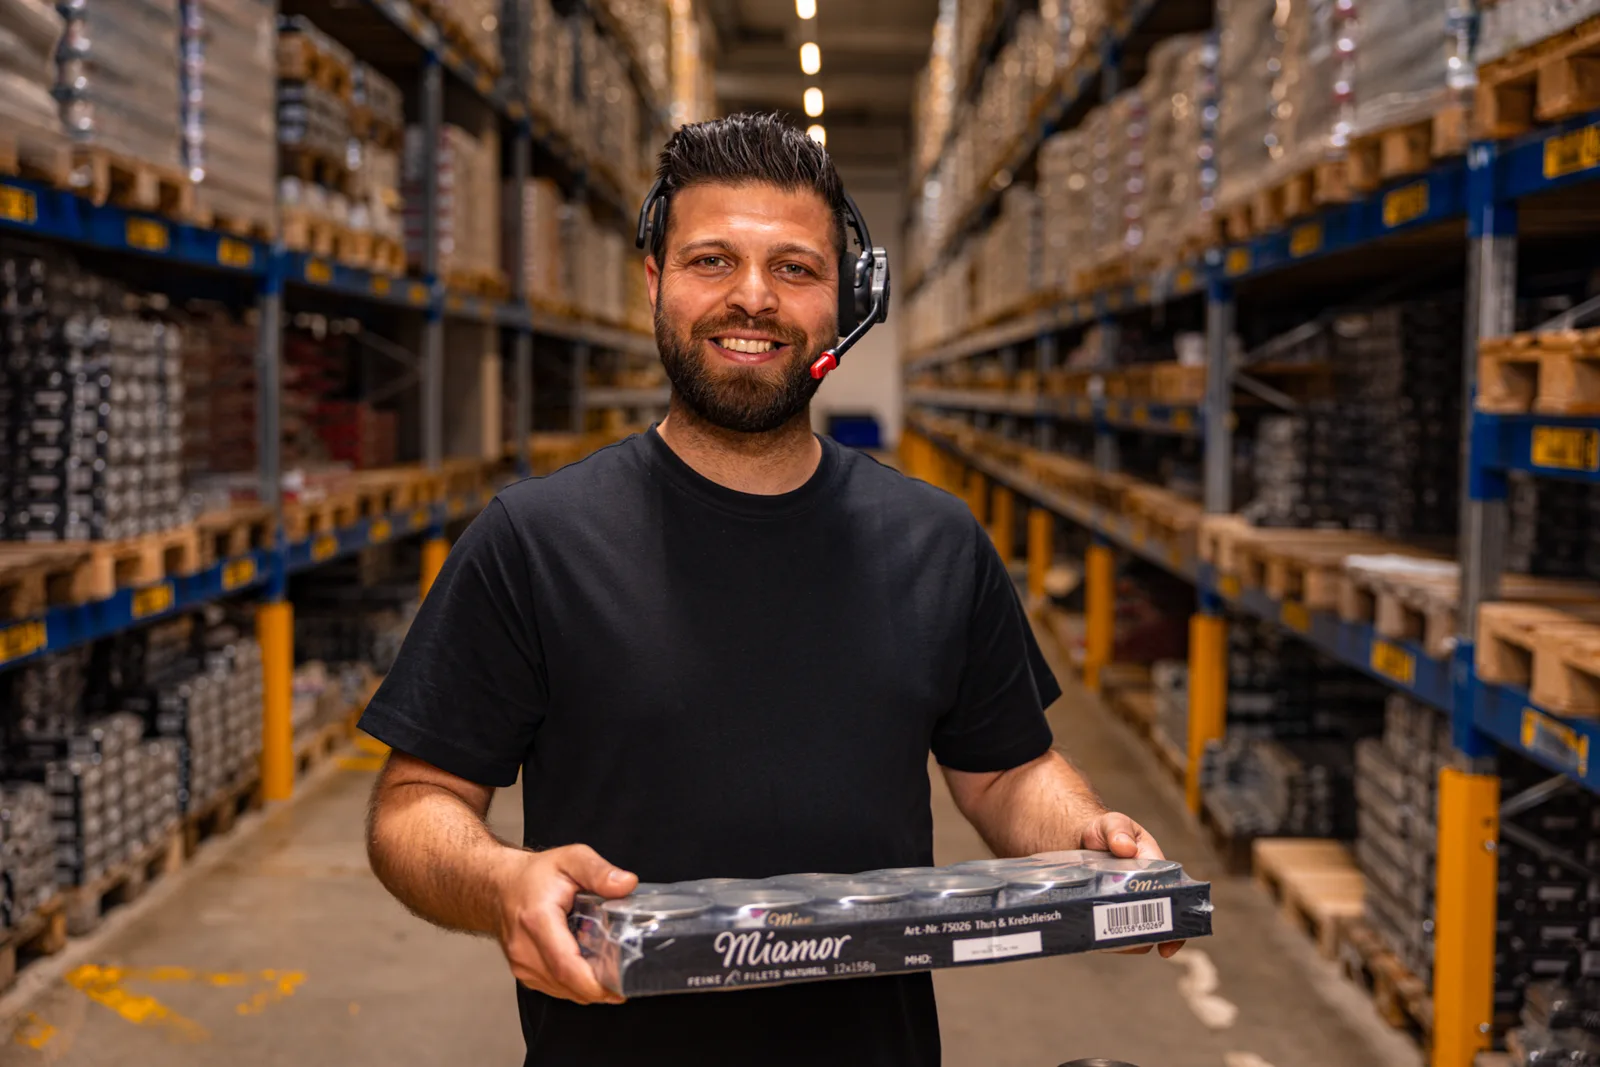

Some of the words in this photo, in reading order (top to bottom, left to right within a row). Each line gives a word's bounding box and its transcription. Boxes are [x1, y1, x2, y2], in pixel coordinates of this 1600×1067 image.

[942, 920, 972, 933] 75026
[998, 917, 1007, 928] &
[1008, 910, 1062, 927] Krebsfleisch
[1111, 924, 1136, 935] 000158
[713, 930, 852, 968] Miamor
[904, 954, 932, 966] MHD:
[687, 974, 721, 987] FEINE
[743, 969, 781, 981] FILETS
[783, 966, 828, 978] NATURELL
